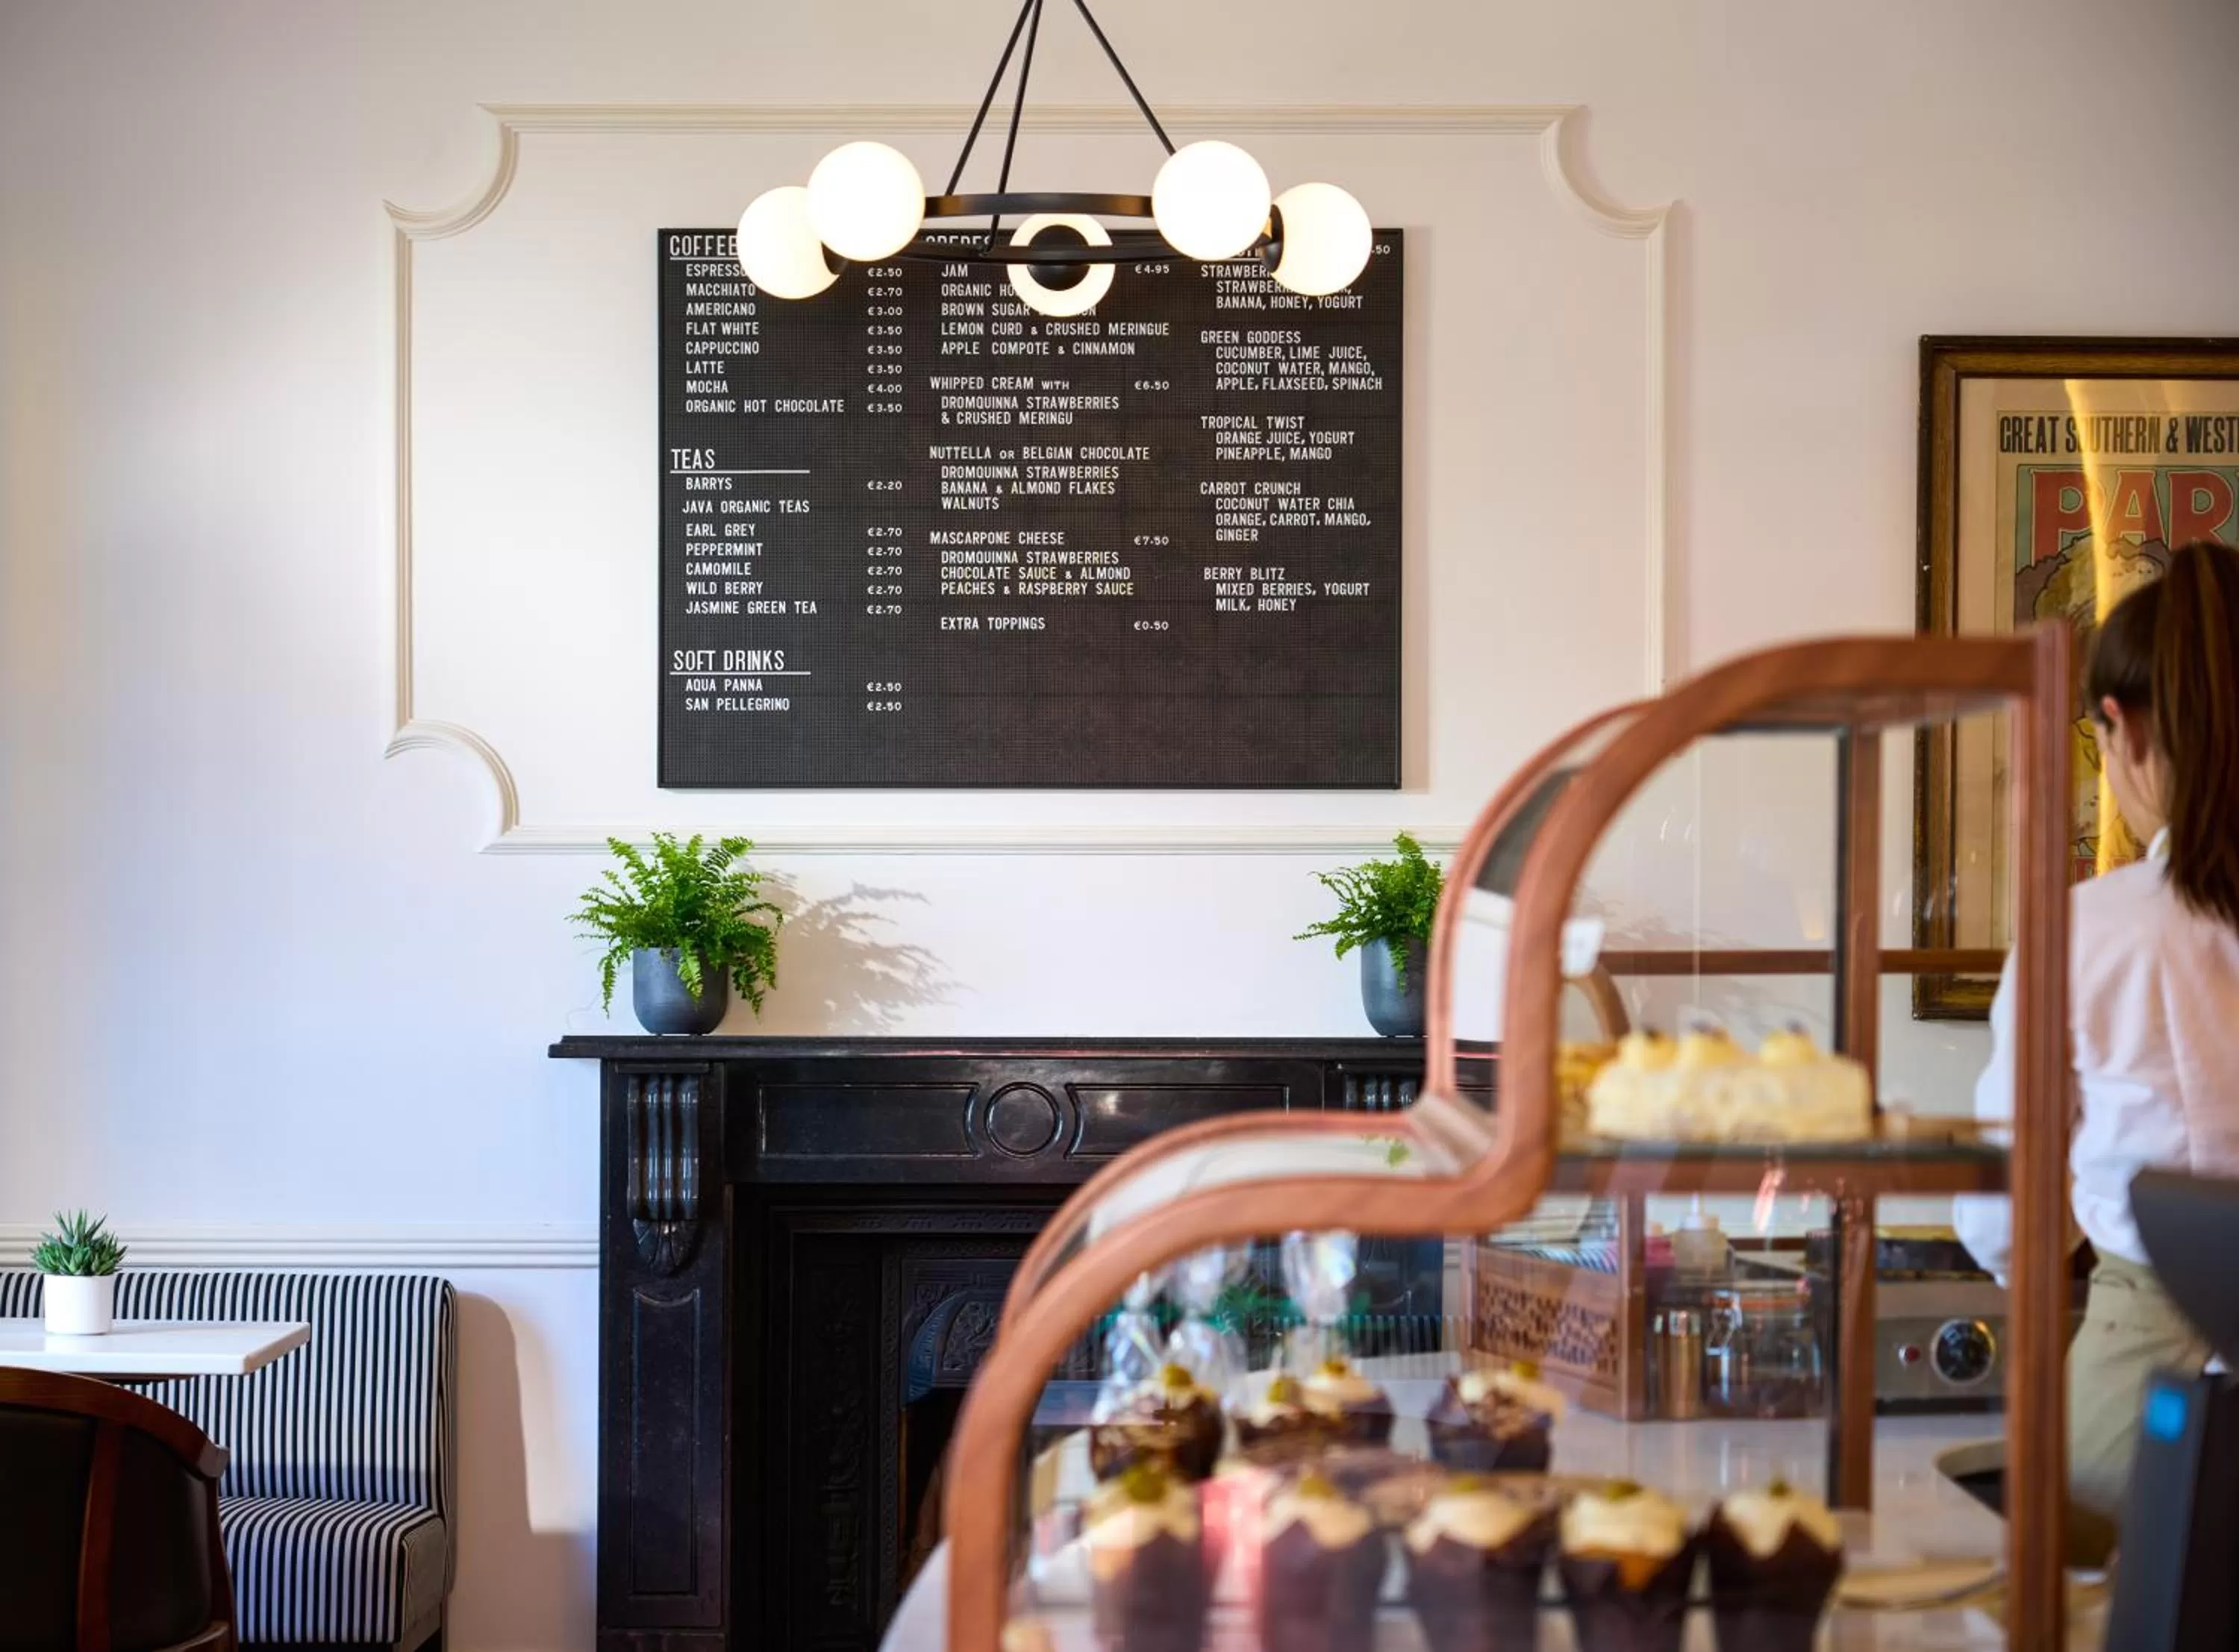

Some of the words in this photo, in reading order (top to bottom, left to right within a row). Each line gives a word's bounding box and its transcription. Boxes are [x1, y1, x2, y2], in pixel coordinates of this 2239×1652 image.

[868, 268, 902, 277] €2.50
[941, 264, 968, 277] JAM
[1135, 265, 1170, 274] €4.95
[1201, 265, 1269, 278] STRAWBER
[686, 284, 755, 296] MACCHIATO
[868, 287, 902, 296] €2.70
[941, 284, 991, 296] ORGANIC
[686, 303, 756, 316] AMERICANO
[868, 307, 902, 316] €3.00
[1217, 296, 1266, 310] BANANA,
[1271, 296, 1313, 310] HONEY,
[1318, 296, 1363, 308] YOGURT
[941, 304, 984, 316] BROWN
[992, 304, 1031, 316] SUGAR
[686, 322, 715, 335] FLAT
[722, 322, 759, 335] WHITE
[868, 326, 902, 335] €3.50
[941, 323, 984, 335] LEMON
[992, 323, 1022, 335] CURD
[1031, 326, 1037, 335] &
[1046, 323, 1100, 335] CRUSHED
[1108, 323, 1170, 335] MERINGUE
[1201, 331, 1239, 344] GREEN
[1247, 331, 1301, 344] GODDESS
[686, 342, 759, 354] CAPPUCCINO
[868, 345, 902, 354] €3.50
[941, 342, 979, 354] APPLE
[992, 342, 1049, 354] COMPOTE
[1058, 345, 1065, 354] &
[1072, 342, 1135, 354] CINNAMON
[1216, 346, 1286, 360] CUCUMBER,
[1290, 346, 1320, 359] LIME
[1328, 346, 1367, 360] JUICE,
[686, 361, 725, 374] LATTE
[868, 365, 902, 374] €3.50
[1216, 362, 1269, 375] COCONUT
[1278, 362, 1325, 376] WATER,
[1329, 362, 1375, 376] MANGO,
[686, 381, 728, 393] MOCHA
[868, 384, 902, 393] €4.00
[930, 377, 984, 389] WHIPPED
[992, 377, 1034, 389] CREAM
[1041, 381, 1069, 389] WITH
[1134, 381, 1169, 390] €6.50
[1216, 378, 1258, 390] APPLE,
[1263, 378, 1328, 390] FLAXSEED,
[1332, 378, 1382, 389] SPINACH
[686, 400, 736, 413] ORGANIC
[744, 400, 766, 413] HOT
[775, 400, 844, 413] CHOCOLATE
[868, 404, 902, 413] €3.50
[941, 397, 1018, 410] DROMQUINNA
[1027, 397, 1119, 410] STRAWBERRIES
[941, 412, 950, 425] &
[957, 412, 1011, 425] CRUSHED
[1019, 412, 1072, 425] MERINGU
[1201, 416, 1258, 429] TROPICAL
[1267, 416, 1305, 429] TWIST
[1216, 432, 1261, 445] ORANGE
[1309, 432, 1355, 445] YOGURT
[2000, 416, 2060, 453] GREAT
[2166, 416, 2179, 453] &
[2186, 416, 2239, 453] WEST
[672, 449, 715, 469] TEAS
[930, 447, 991, 460] NUTTELLA
[1023, 447, 1072, 460] BELGIAN
[1081, 447, 1150, 460] CHOCOLATE
[1216, 447, 1284, 462] PINEAPPLE,
[1290, 447, 1332, 460] MANGO
[941, 466, 1018, 478] DROMQUINNA
[1027, 466, 1119, 478] STRAWBERRIES
[686, 478, 732, 489] BARRYS
[867, 481, 902, 489] €2.20
[941, 482, 987, 494] BANANA
[996, 485, 1003, 494] &
[1011, 482, 1061, 494] ALMOND
[1069, 482, 1115, 494] FLAKES
[1201, 482, 1246, 495] CARROT
[1255, 482, 1301, 495] CRUNCH
[682, 501, 712, 513] JAVA
[721, 501, 770, 513] ORGANIC
[778, 501, 810, 513] TEAS
[942, 497, 999, 510] WALNUTS
[1216, 498, 1269, 510] COCONUT
[1278, 498, 1320, 510] WATER
[1328, 498, 1355, 510] CHIA
[2030, 469, 2239, 566] PAR
[686, 524, 716, 536] EARL
[725, 524, 755, 536] GREY
[867, 528, 902, 536] €2.70
[1216, 529, 1258, 541] GINGER
[930, 532, 1010, 545] MASCARPONE
[1019, 532, 1064, 545] CHEESE
[1134, 536, 1169, 545] €7.50
[686, 543, 763, 556] PEPPERMINT
[867, 547, 902, 556] €2.70
[941, 551, 1018, 564] DROMQUINNA
[1027, 551, 1119, 564] STRAWBERRIES
[686, 563, 751, 575] CAMOMILE
[867, 566, 902, 575] €2.70
[941, 567, 1010, 580] CHOCOLATE
[1019, 567, 1057, 580] SAUCE
[1065, 570, 1072, 580] &
[1081, 567, 1131, 580] ALMOND
[1204, 567, 1242, 580] BERRY
[1251, 567, 1284, 580] BLITZ
[686, 582, 716, 595] WILD
[725, 582, 763, 595] BERRY
[867, 586, 902, 595] €2.70
[941, 583, 995, 595] PEACHES
[1004, 586, 1011, 595] &
[1019, 583, 1087, 595] RASPBERRY
[1096, 583, 1134, 595] SAUCE
[1216, 583, 1255, 595] MIXED
[1324, 583, 1370, 595] YOGURT
[686, 601, 739, 614] JASMINE
[747, 601, 786, 614] GREEN
[794, 601, 816, 614] TEA
[867, 605, 902, 614] €2.70
[1258, 598, 1296, 611] HONEY
[941, 617, 979, 630] EXTRA
[988, 617, 1046, 630] TOPPINGS
[1134, 621, 1169, 630] €0.50
[673, 650, 716, 671] SOFT
[723, 650, 784, 671] DRINKS
[686, 679, 716, 691] AQUA
[725, 679, 763, 691] PANNA
[866, 683, 902, 692] €2.50
[686, 698, 708, 710] SAN
[716, 698, 790, 710] PELLEGRINO
[866, 702, 902, 711] €2.50
